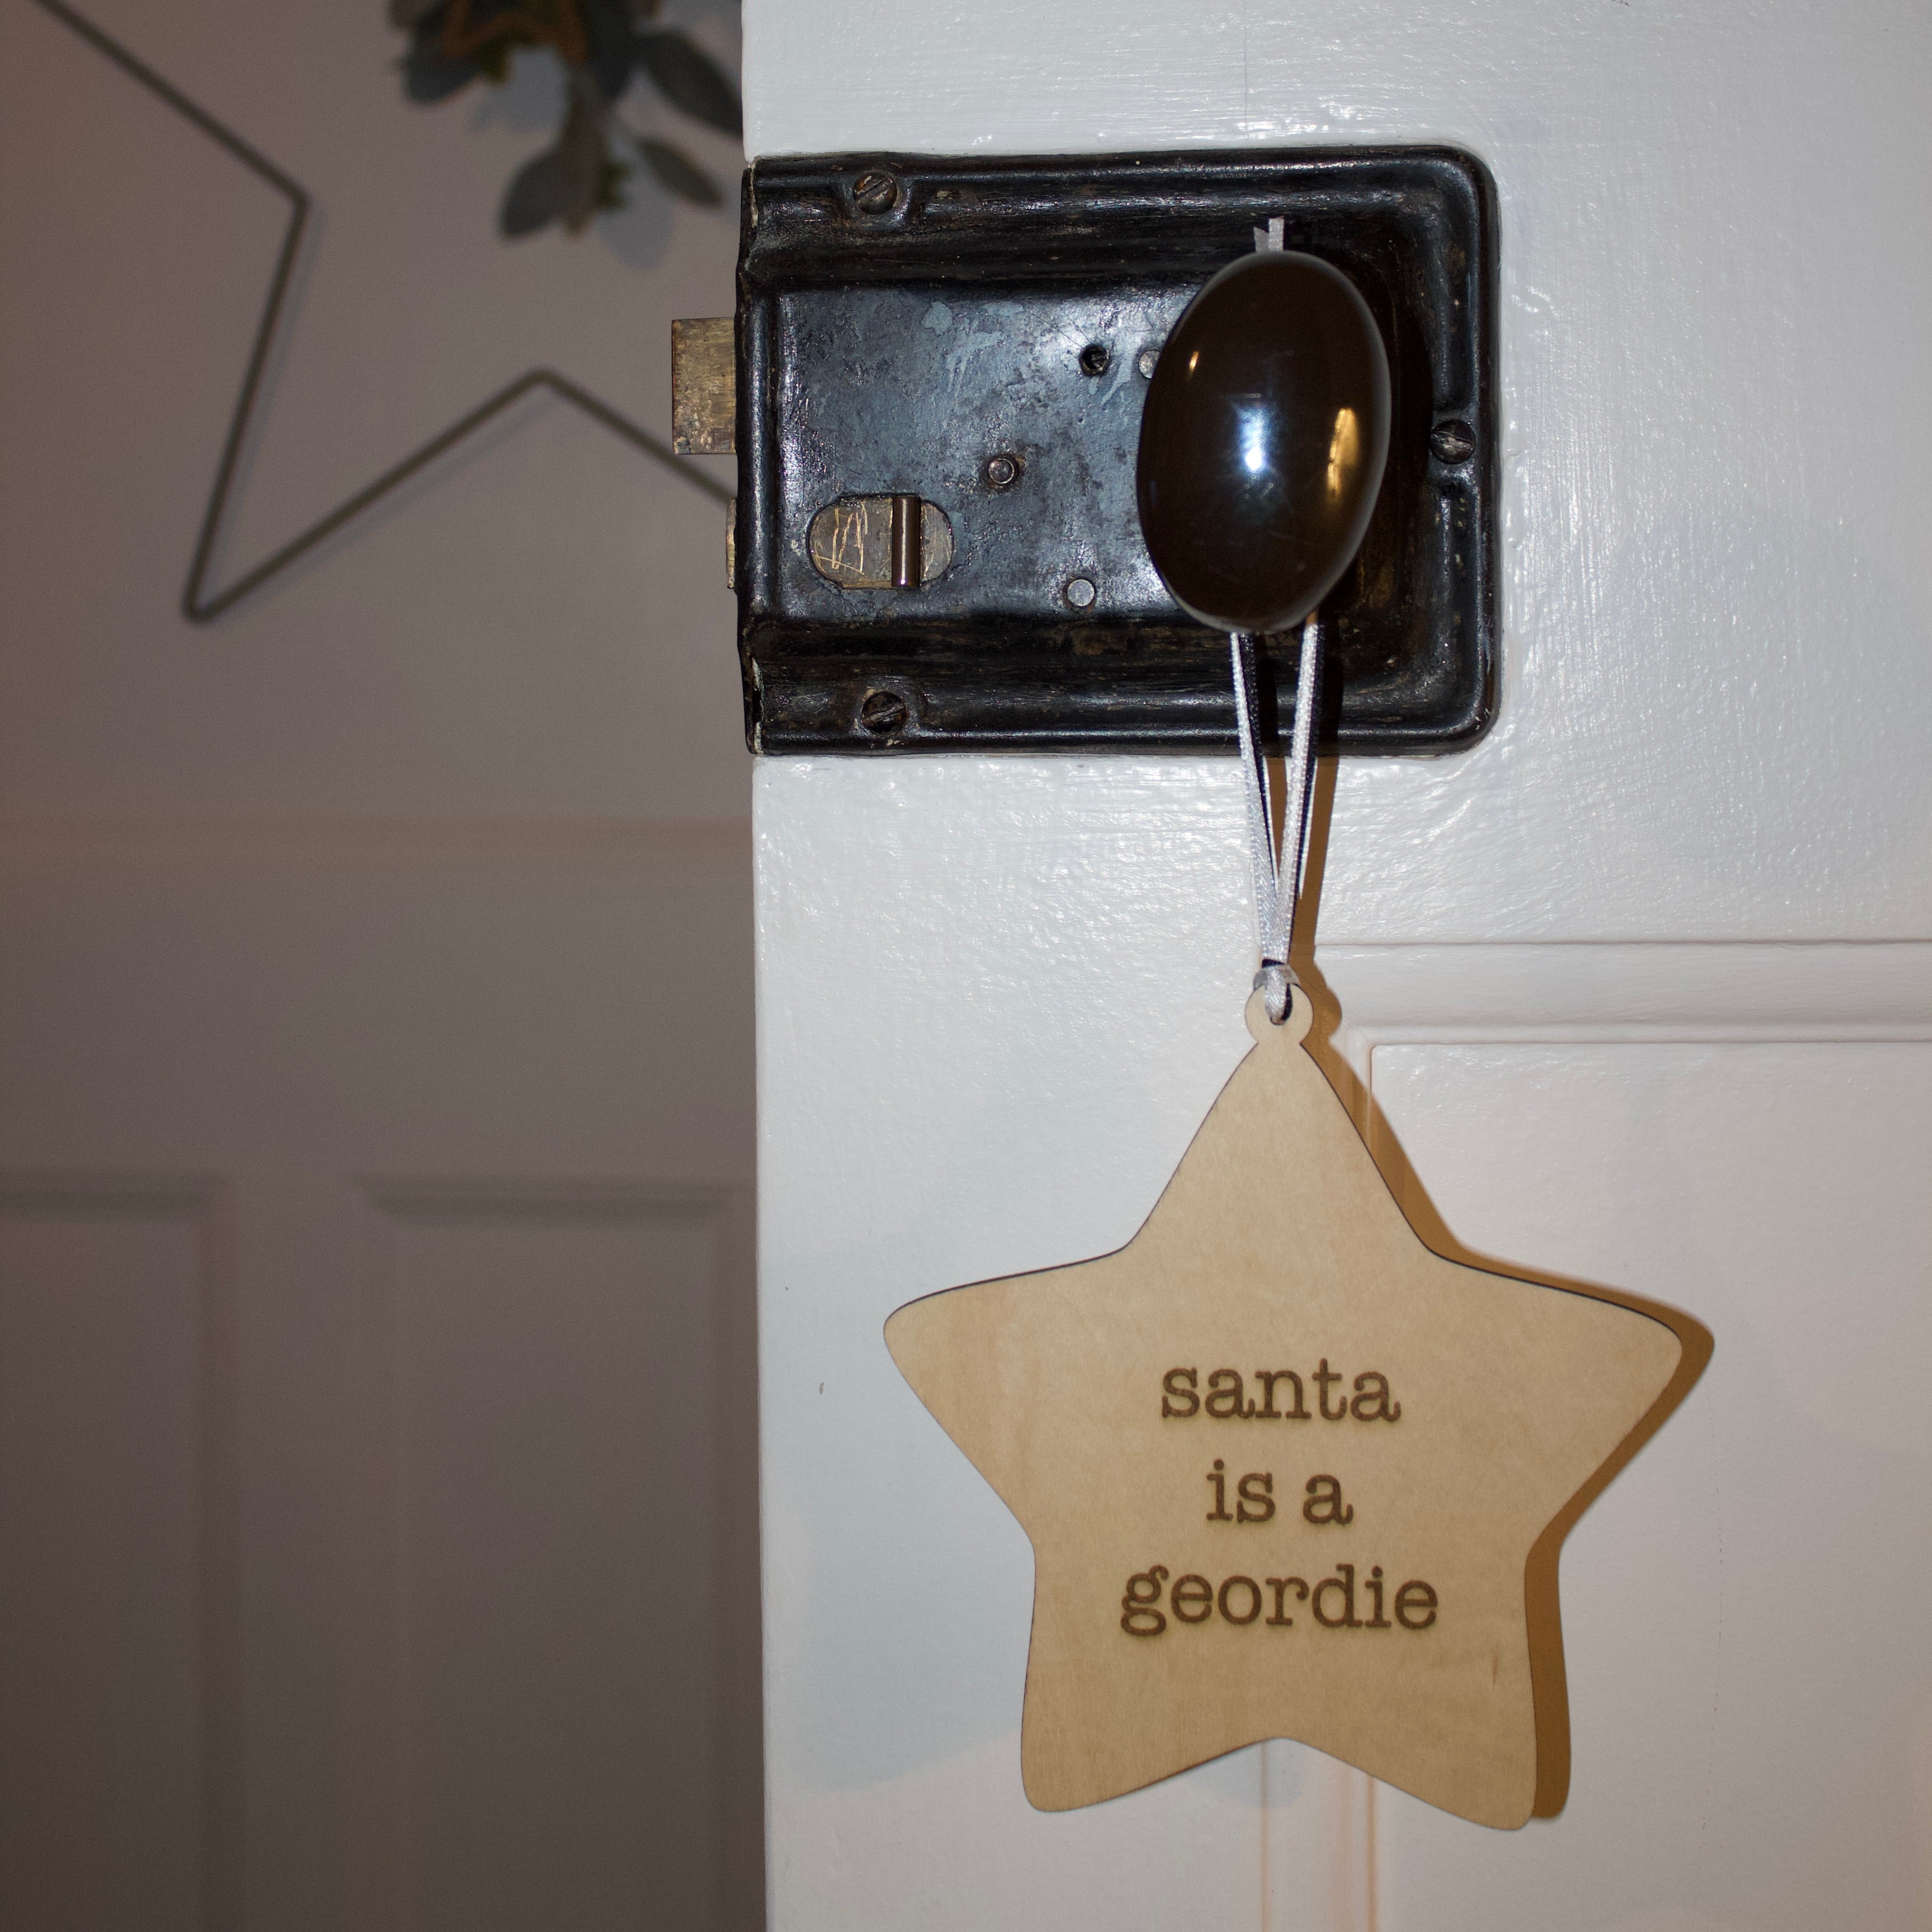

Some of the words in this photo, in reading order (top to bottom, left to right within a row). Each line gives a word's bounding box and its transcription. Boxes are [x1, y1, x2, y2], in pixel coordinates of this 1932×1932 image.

[1162, 1358, 1401, 1423] santa
[1206, 1459, 1276, 1524] is
[1303, 1474, 1354, 1526] a
[1121, 1564, 1438, 1637] geordie
